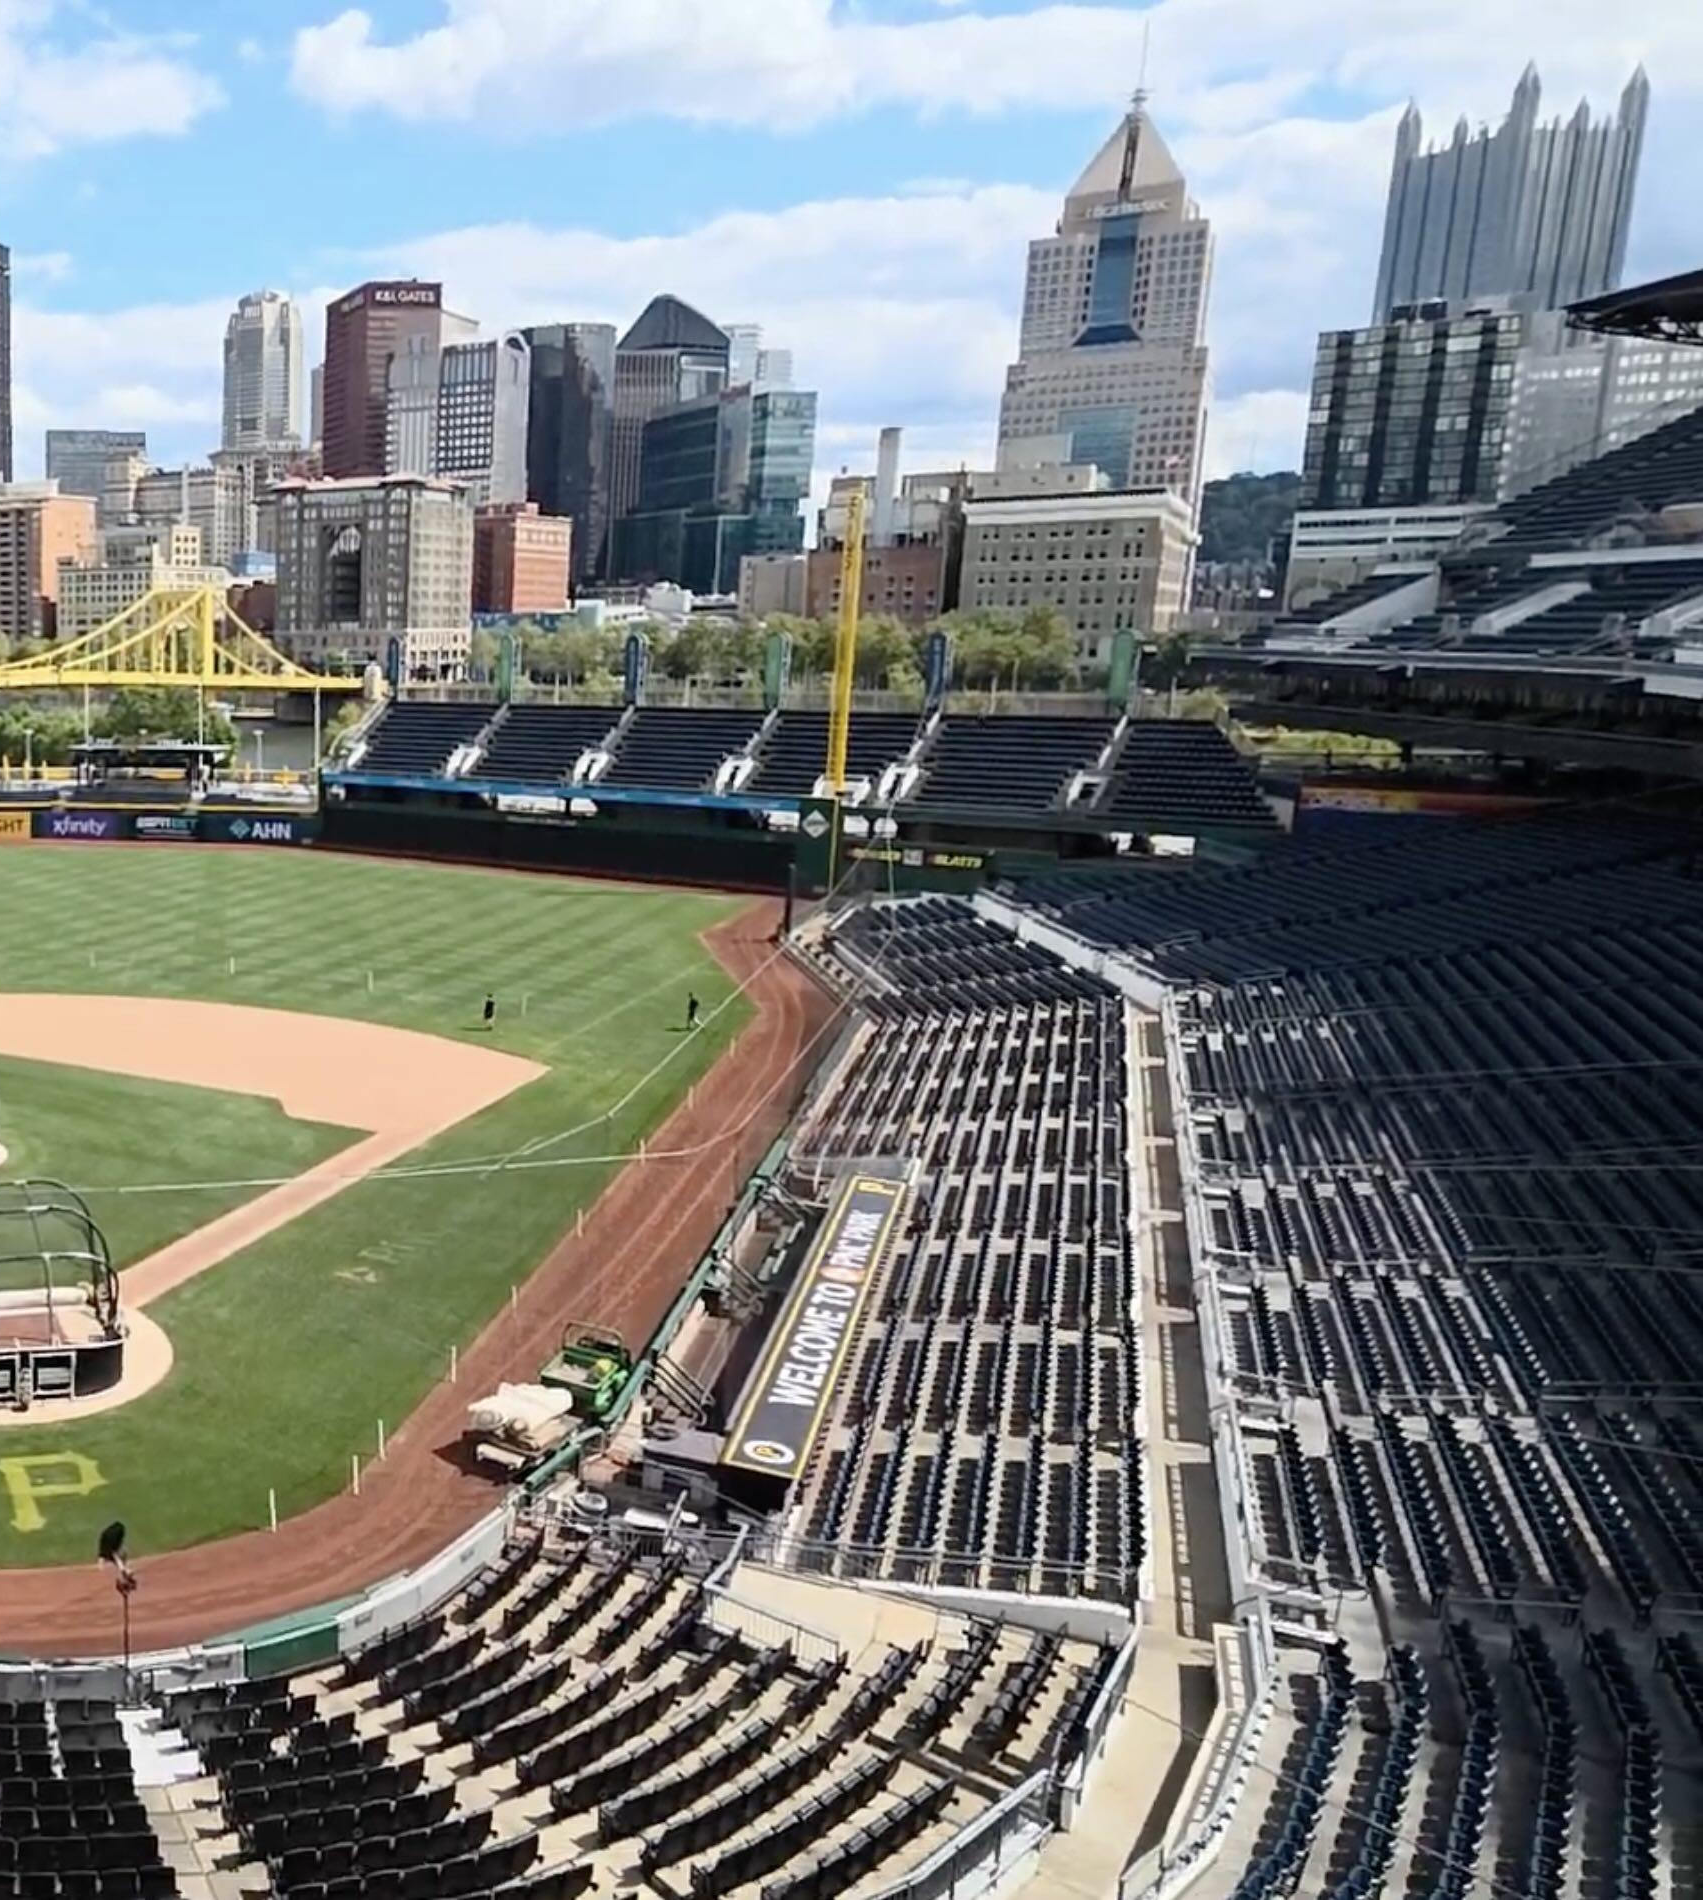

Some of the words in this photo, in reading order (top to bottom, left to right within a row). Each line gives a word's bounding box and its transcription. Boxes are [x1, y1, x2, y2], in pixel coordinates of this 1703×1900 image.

[397, 289, 436, 303] GATES
[52, 813, 108, 838] xfinity
[251, 821, 293, 840] AHN
[847, 1210, 883, 1241] PARK
[828, 1241, 871, 1269] PNC
[815, 1282, 856, 1307] TO
[768, 1306, 849, 1407] WELCOME
